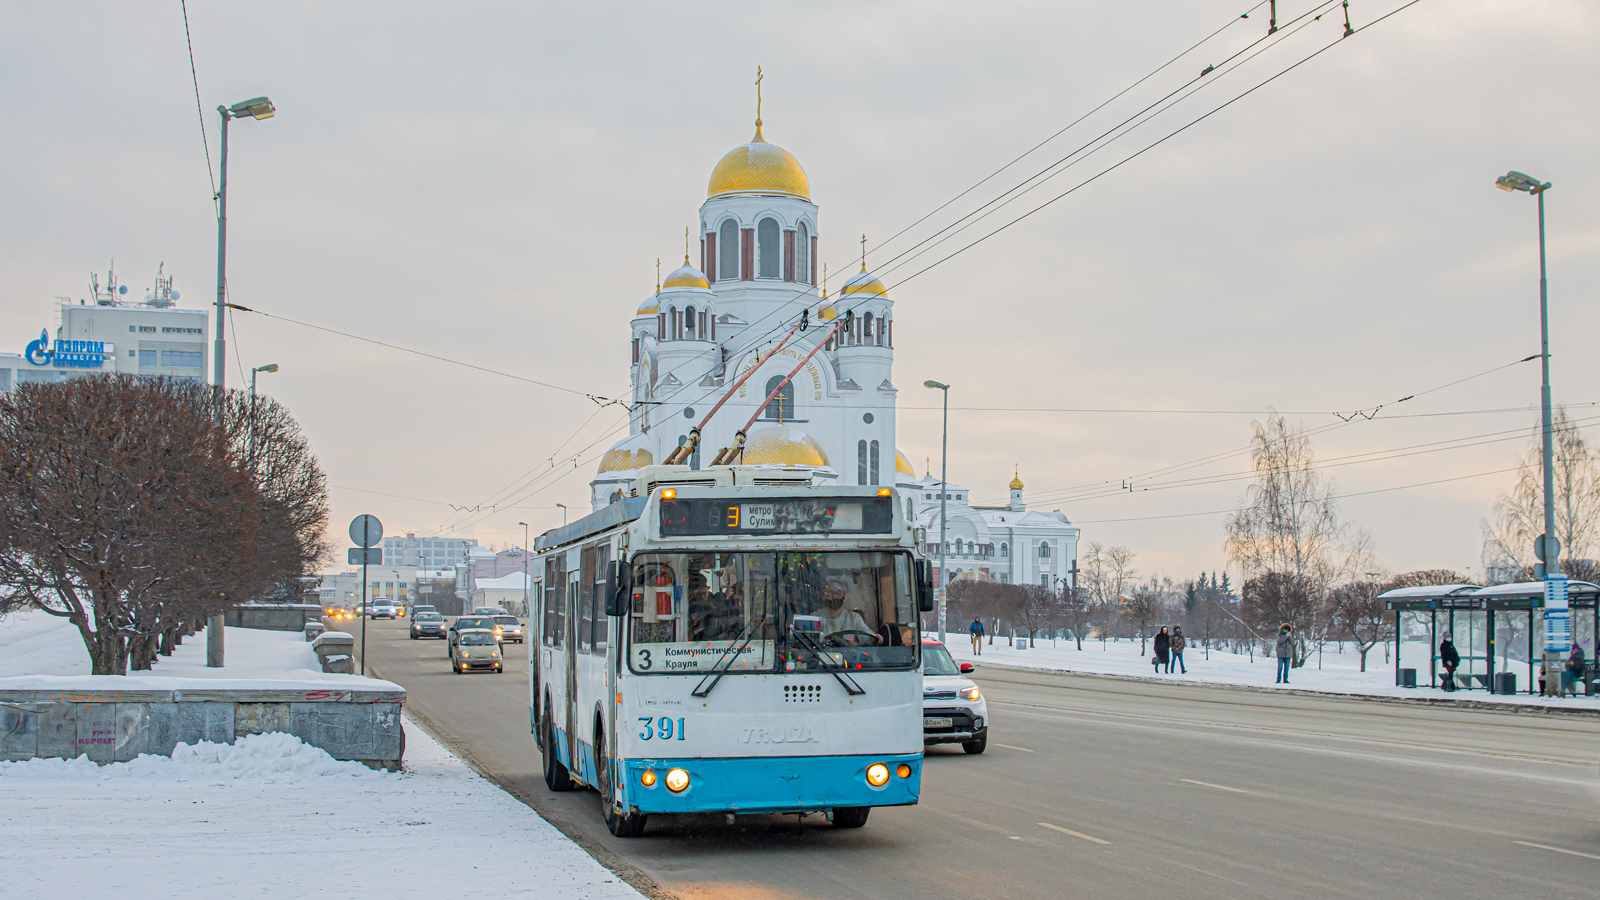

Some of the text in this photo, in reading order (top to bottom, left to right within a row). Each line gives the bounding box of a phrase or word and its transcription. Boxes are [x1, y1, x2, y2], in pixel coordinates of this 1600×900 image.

[53, 339, 104, 353] ГАЗПРОМ
[54, 353, 104, 361] ТРАНСГАЗ
[727, 506, 740, 527] 3
[749, 506, 772, 517] метро
[638, 649, 653, 670] 3
[665, 659, 698, 670] Крауля
[638, 716, 686, 741] 391
[742, 727, 819, 743] TROLZA
